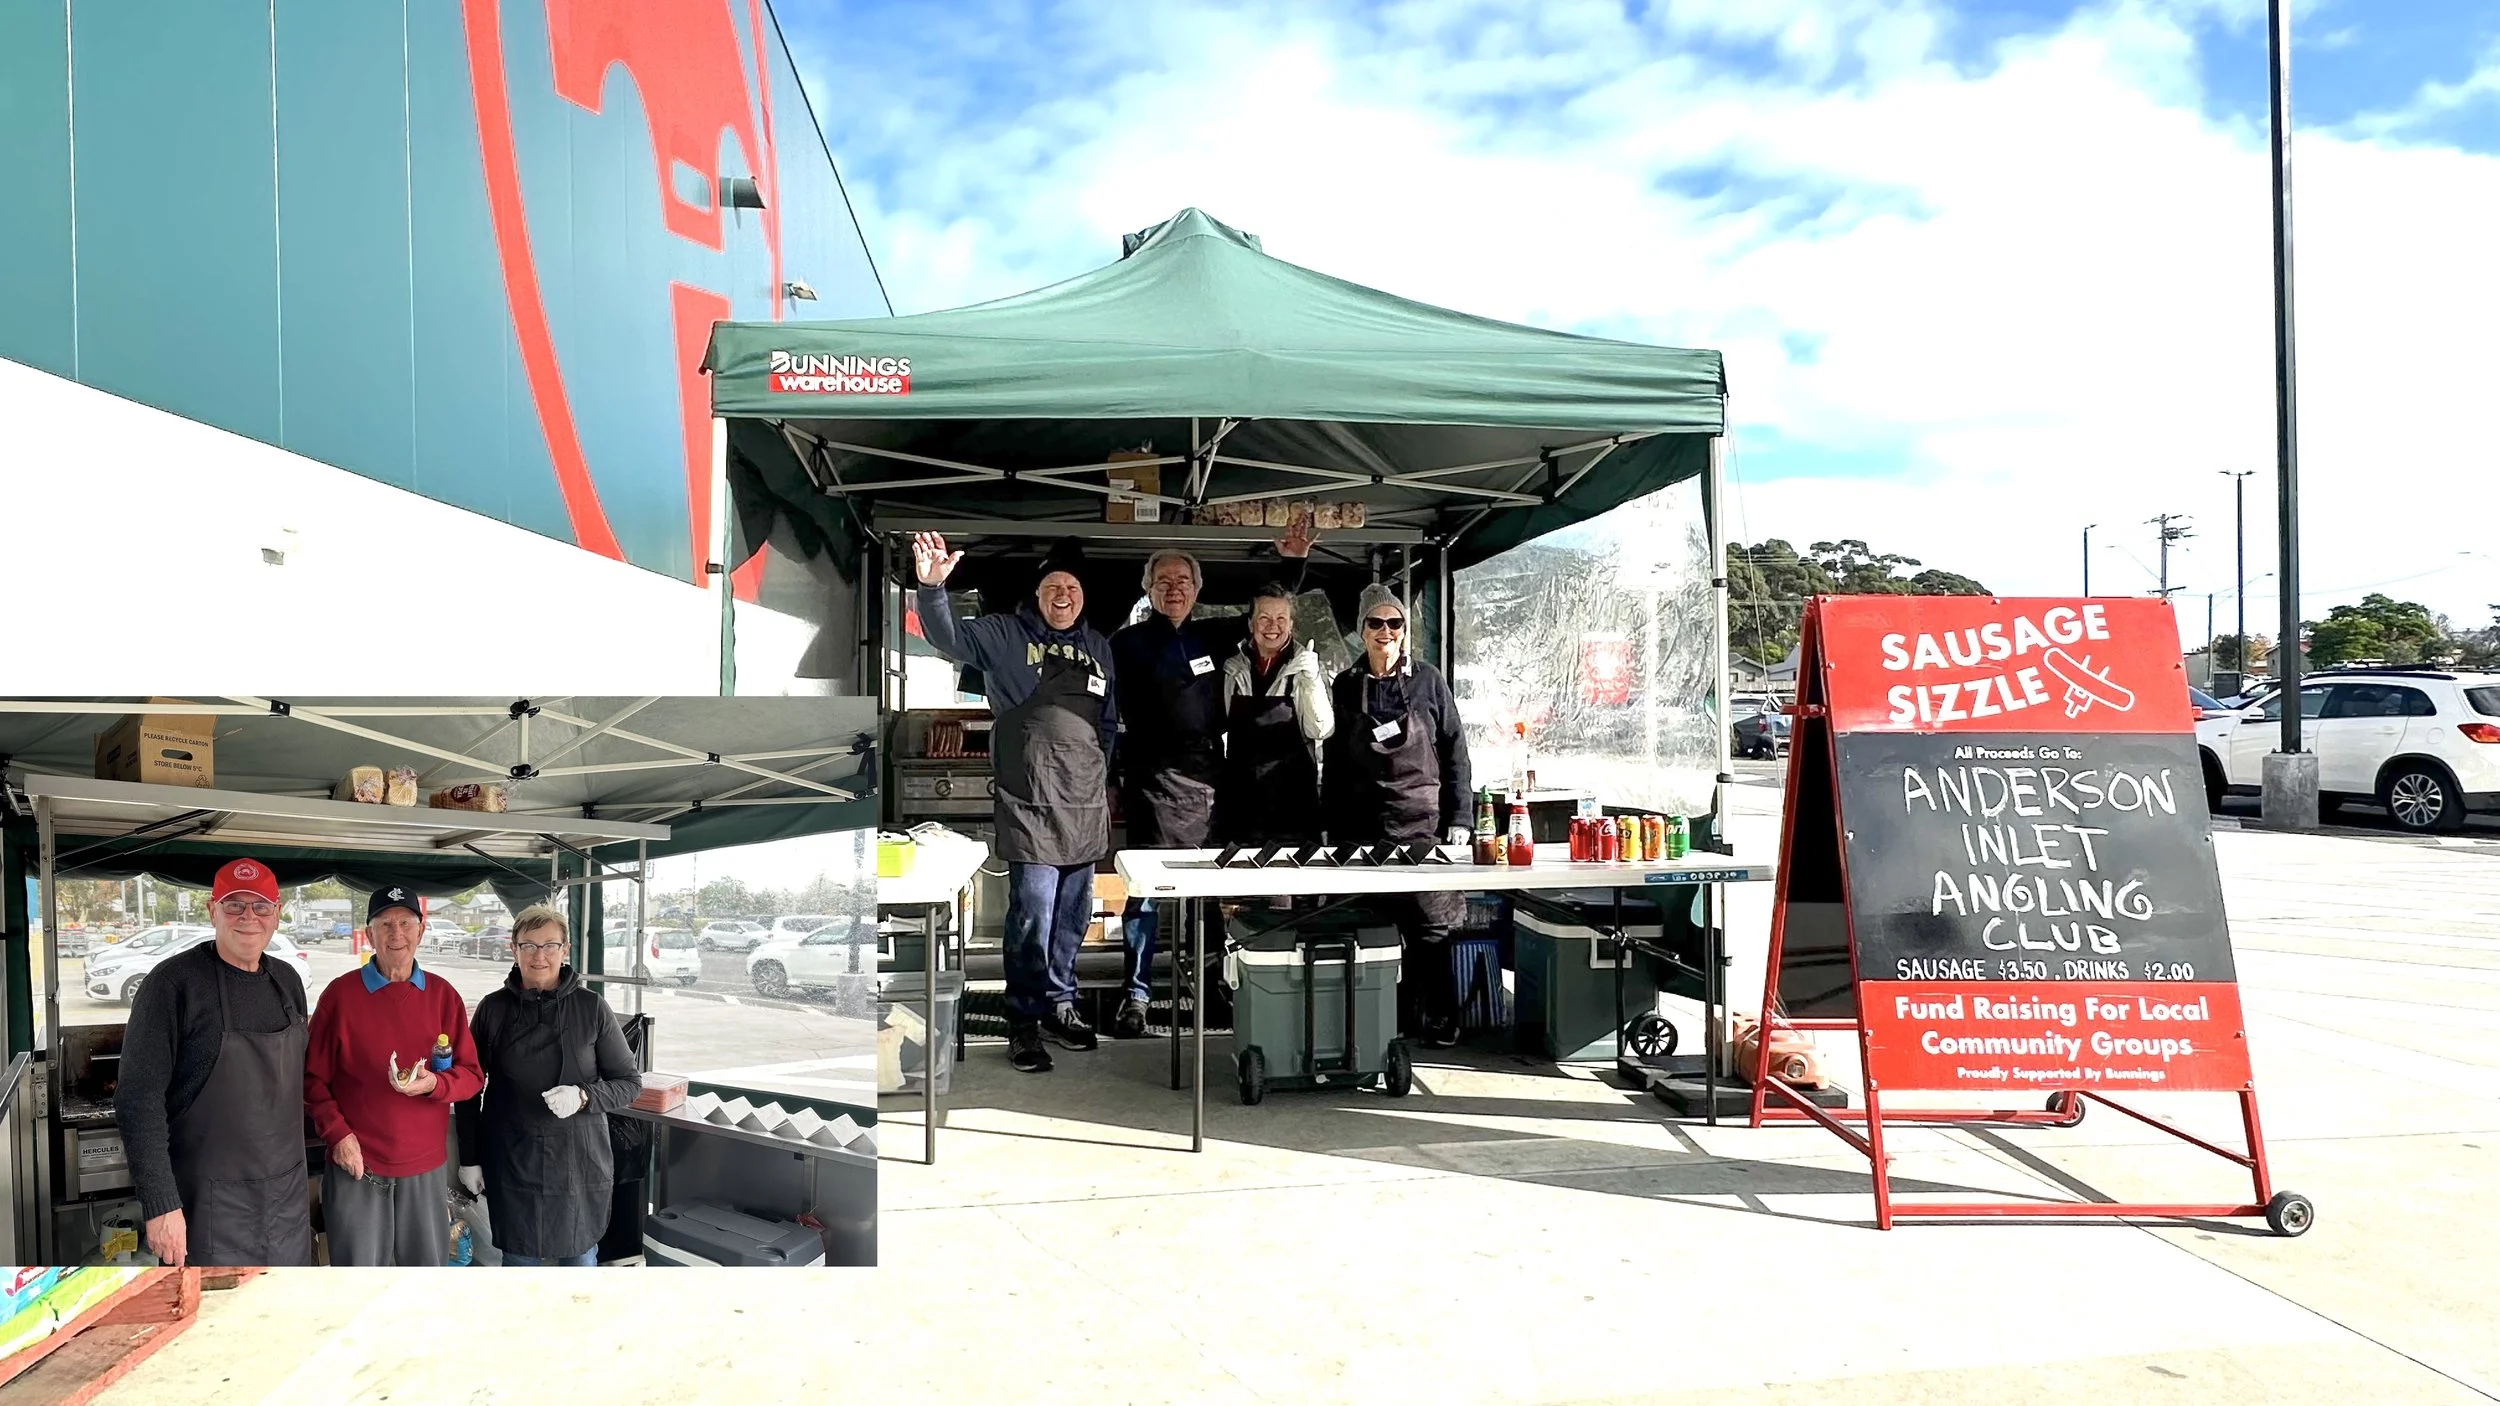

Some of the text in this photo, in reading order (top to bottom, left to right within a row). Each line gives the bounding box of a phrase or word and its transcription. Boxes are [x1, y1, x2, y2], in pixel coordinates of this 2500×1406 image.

[769, 350, 912, 376] BUNNINGS
[779, 372, 903, 393] warehouse
[1881, 604, 2110, 670] SAUSAGE
[1888, 666, 2050, 723] SIZZLE
[144, 732, 209, 747] PLEASE RECYCLE CARTON
[1954, 746, 2082, 760] All Proceeds Go To:
[154, 760, 172, 769] STORE
[173, 762, 192, 771] BELOW
[1903, 766, 2177, 817] ANDERSON
[1961, 823, 2109, 871] INLET
[1932, 870, 2153, 920] ANGLING
[1982, 917, 2122, 954] CLUB
[1896, 958, 1987, 981] SAUSAGE
[1998, 959, 2048, 981] $3.50
[2063, 960, 2130, 981] DRINKS
[2144, 962, 2195, 981] $2.00
[1895, 994, 2209, 1026] Fund Raising For Local
[1921, 1030, 2193, 1062] Community Groups
[1956, 1066, 2167, 1082] Proudly Supported By Bunnings
[82, 1146, 119, 1154] HERCULES
